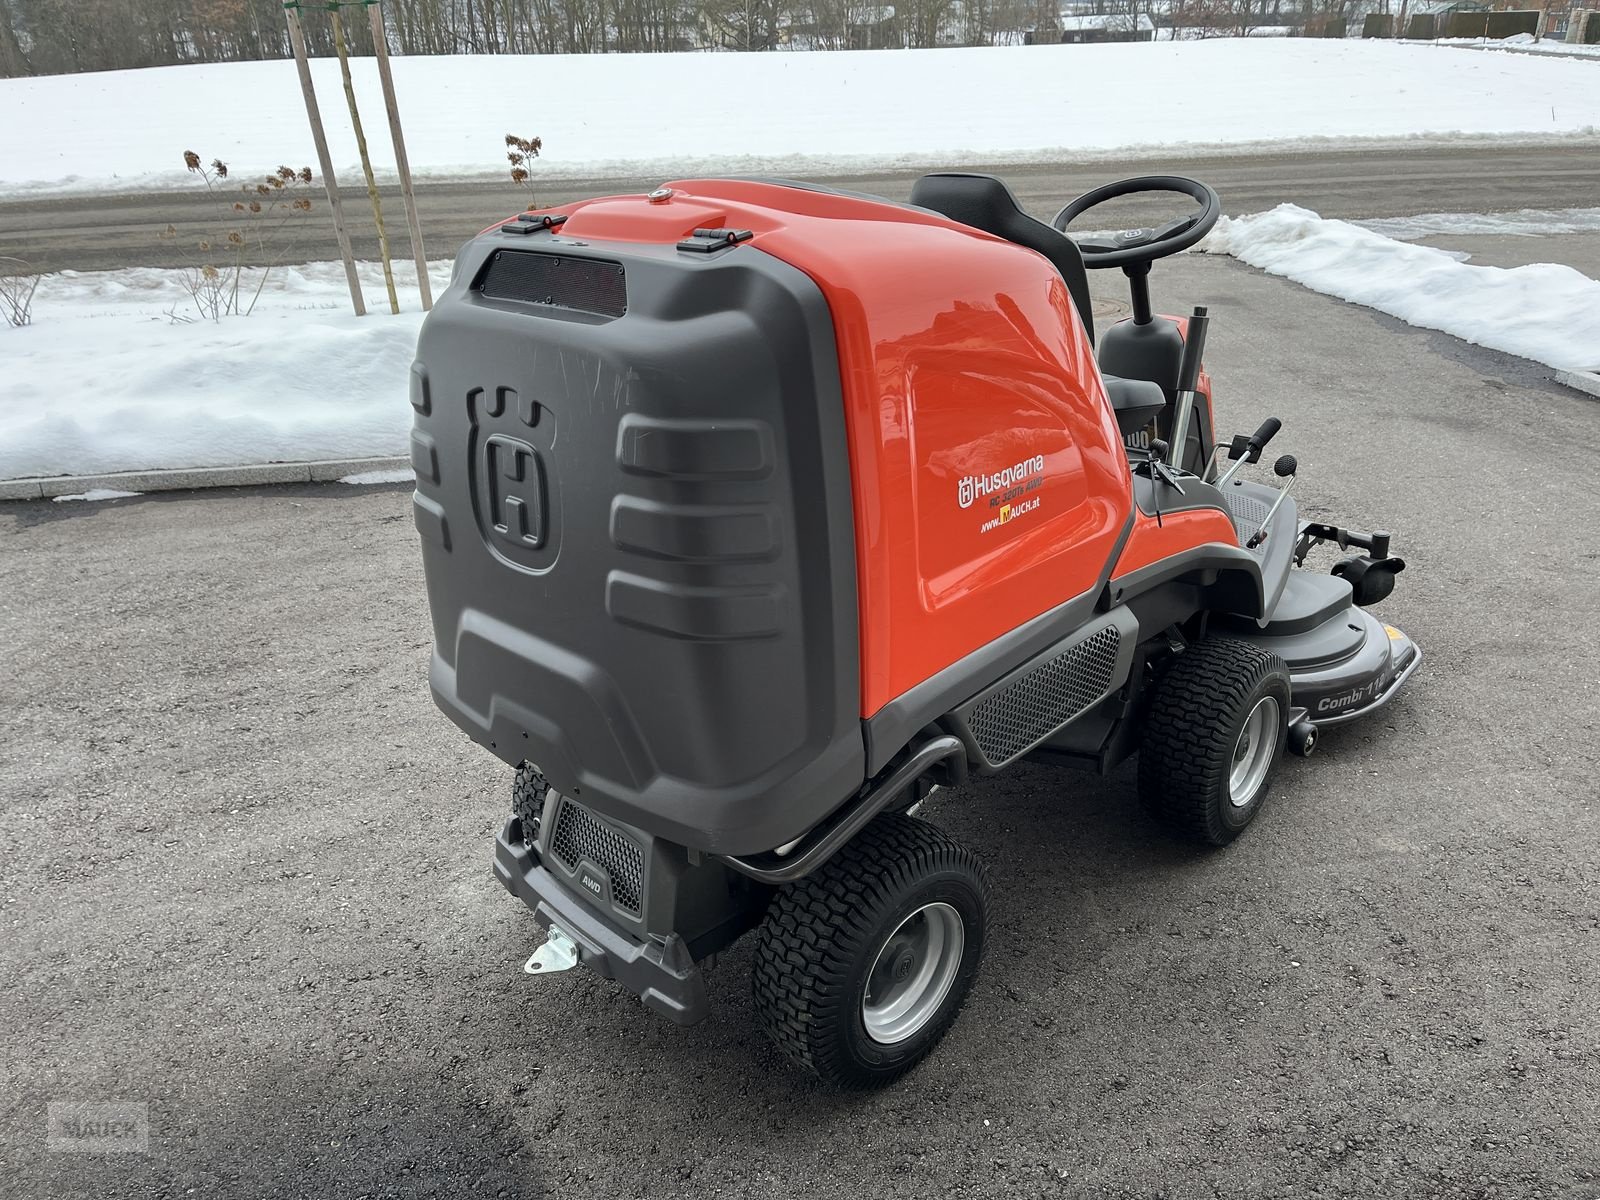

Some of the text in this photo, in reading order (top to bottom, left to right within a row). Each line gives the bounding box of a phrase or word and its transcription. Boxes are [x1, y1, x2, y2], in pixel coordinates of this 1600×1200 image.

[974, 454, 1044, 499] Husqvarna
[1317, 688, 1363, 711] Combi
[582, 875, 601, 893] AWD
